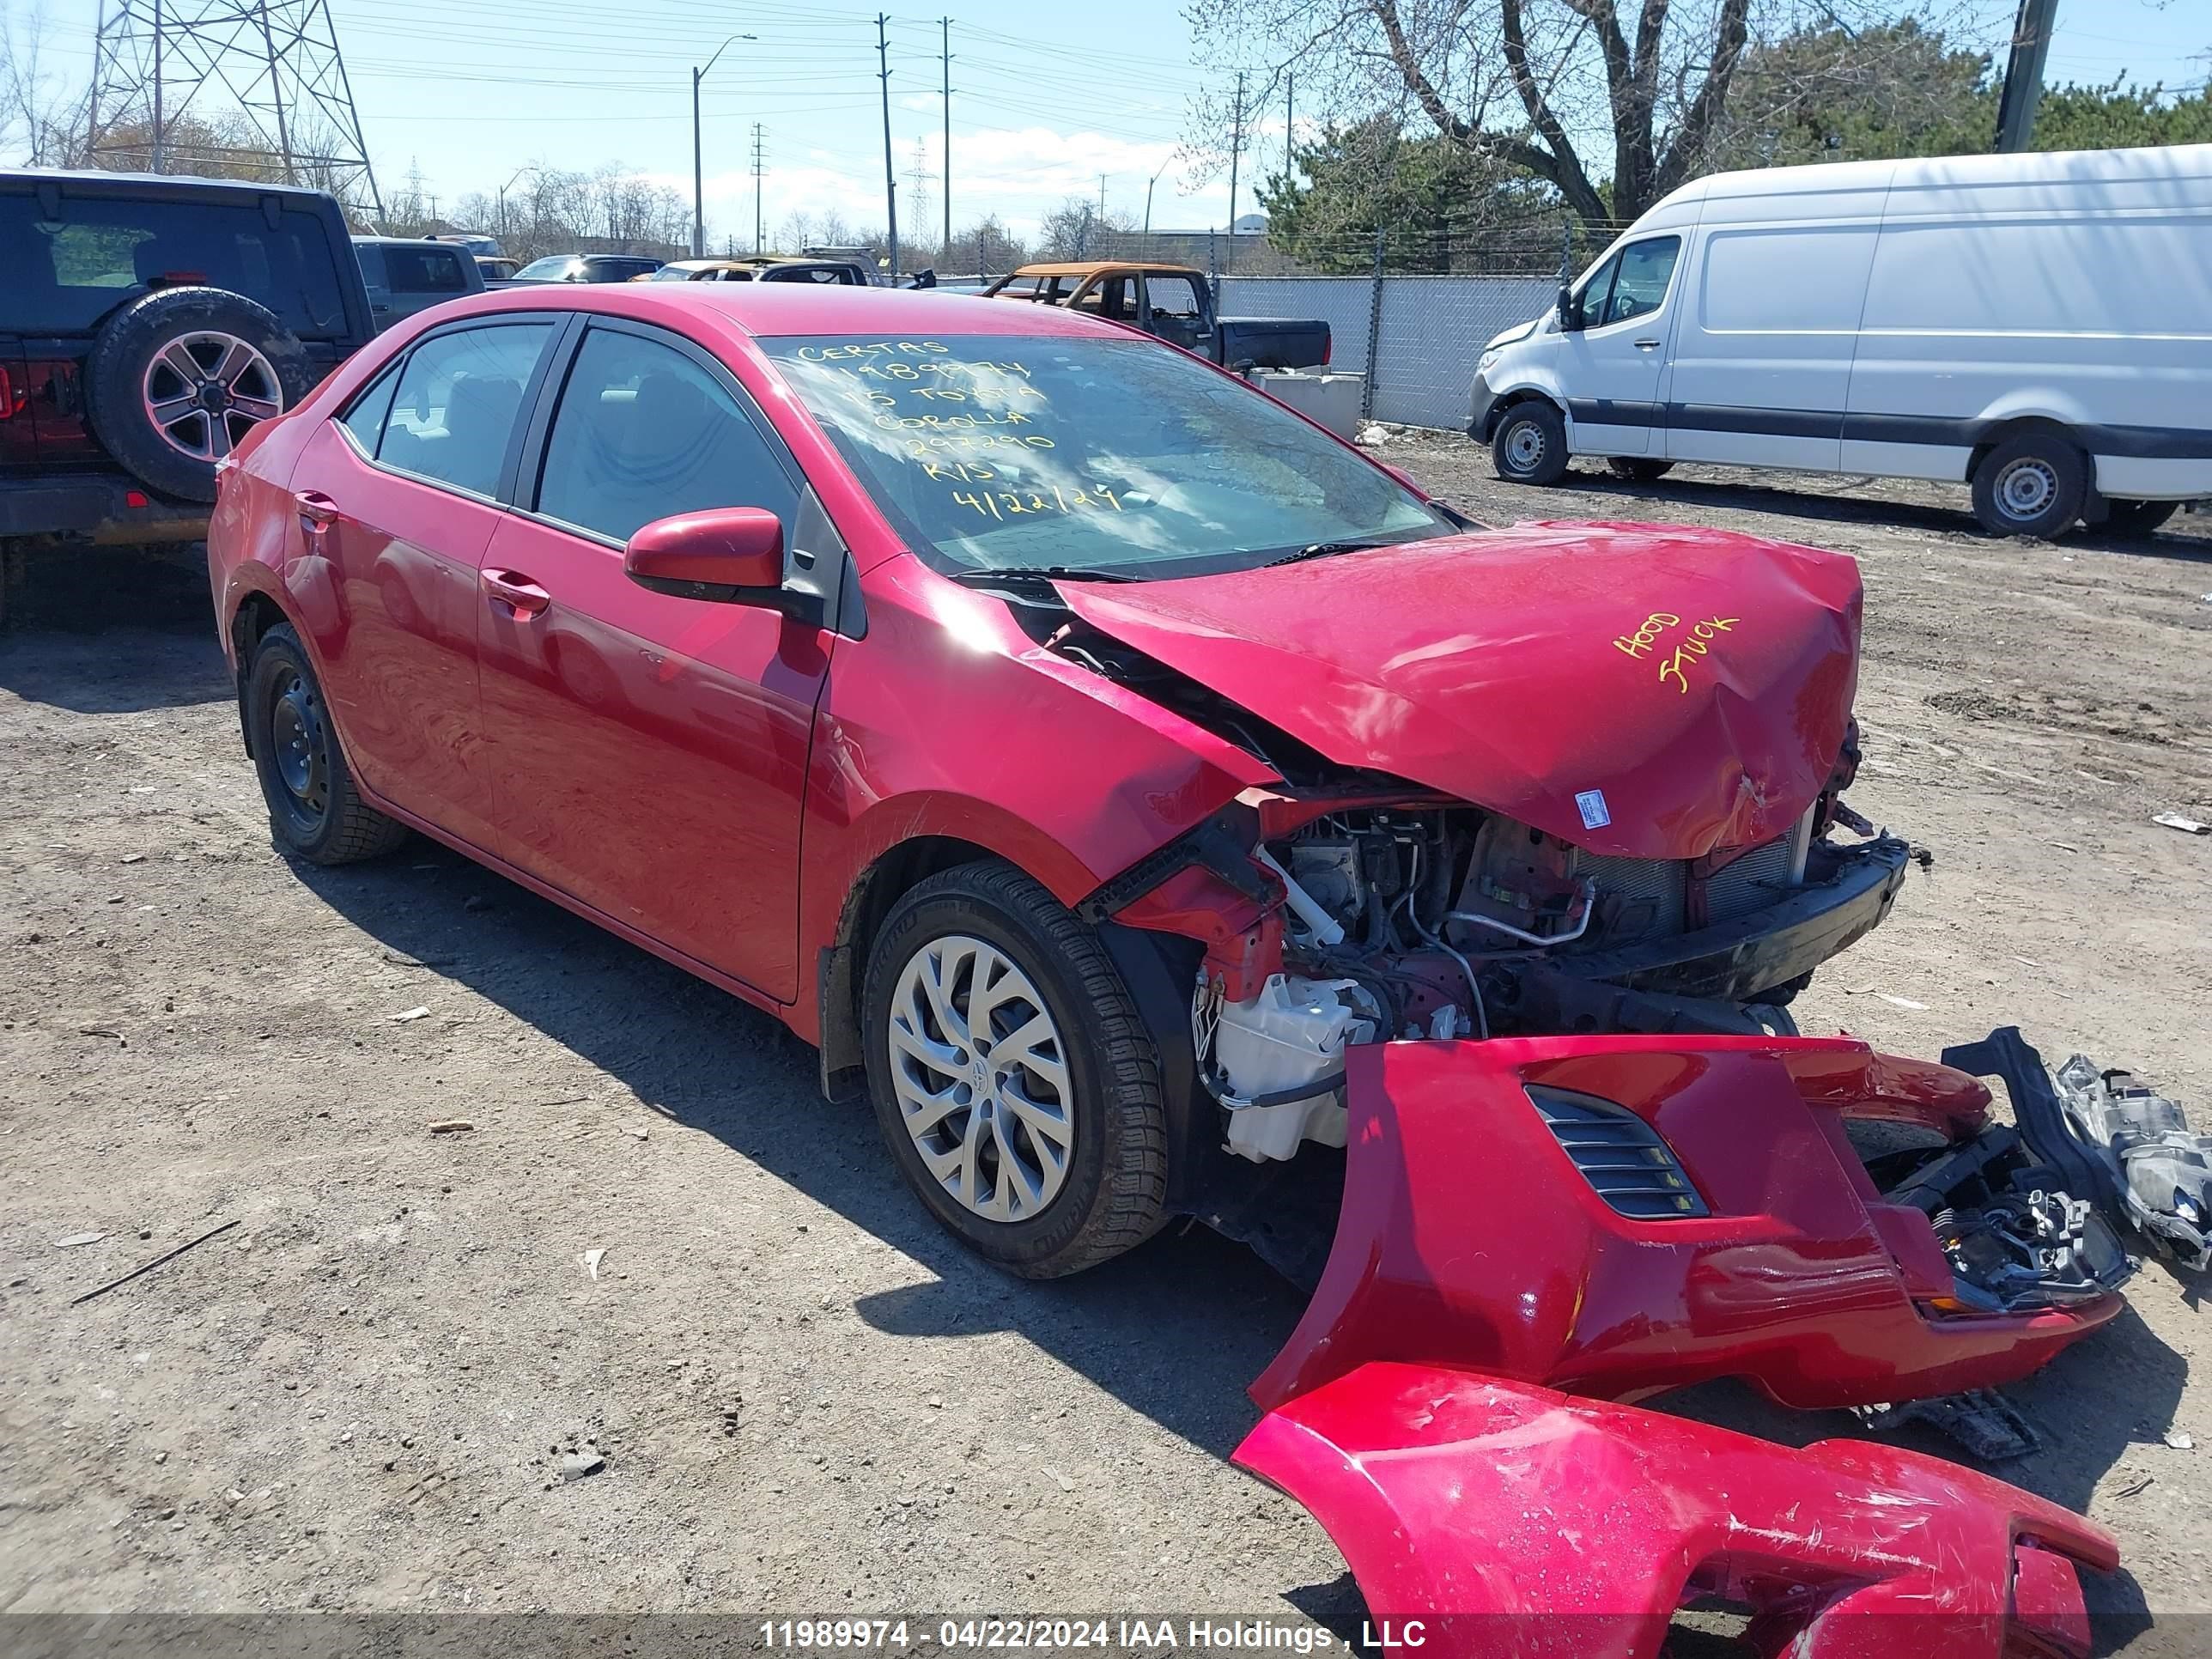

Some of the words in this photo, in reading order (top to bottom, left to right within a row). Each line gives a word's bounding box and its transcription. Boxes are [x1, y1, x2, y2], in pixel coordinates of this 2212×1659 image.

[798, 341, 949, 362] CERTAS
[908, 386, 1048, 402] TOYOTA
[874, 410, 1034, 431] COROLLA
[904, 435, 1056, 456] 297290
[951, 484, 1123, 522] 4/22/24
[1612, 611, 1680, 660] HOOD
[1657, 615, 1742, 695] STUCK
